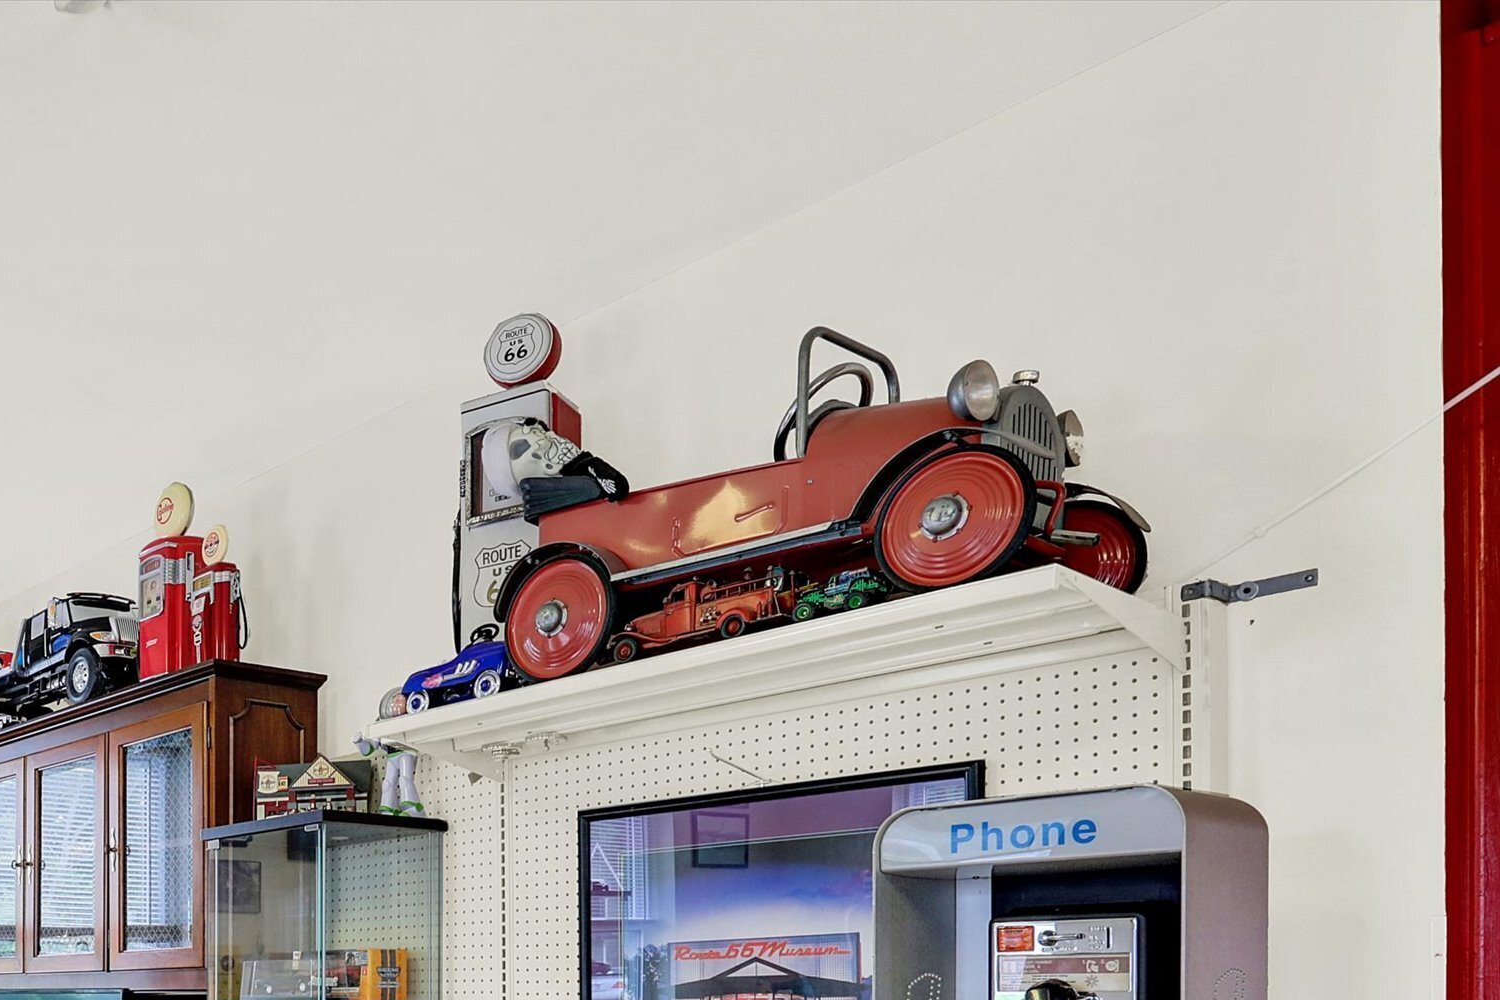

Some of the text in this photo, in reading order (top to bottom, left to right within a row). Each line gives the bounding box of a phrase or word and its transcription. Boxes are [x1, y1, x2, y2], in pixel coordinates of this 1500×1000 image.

[505, 327, 529, 340] ROUTE
[504, 344, 528, 362] 66
[482, 544, 522, 566] ROUTE
[486, 579, 500, 604] 6
[949, 818, 1098, 855] Phone
[673, 944, 728, 961] Route
[757, 940, 852, 958] Museum
